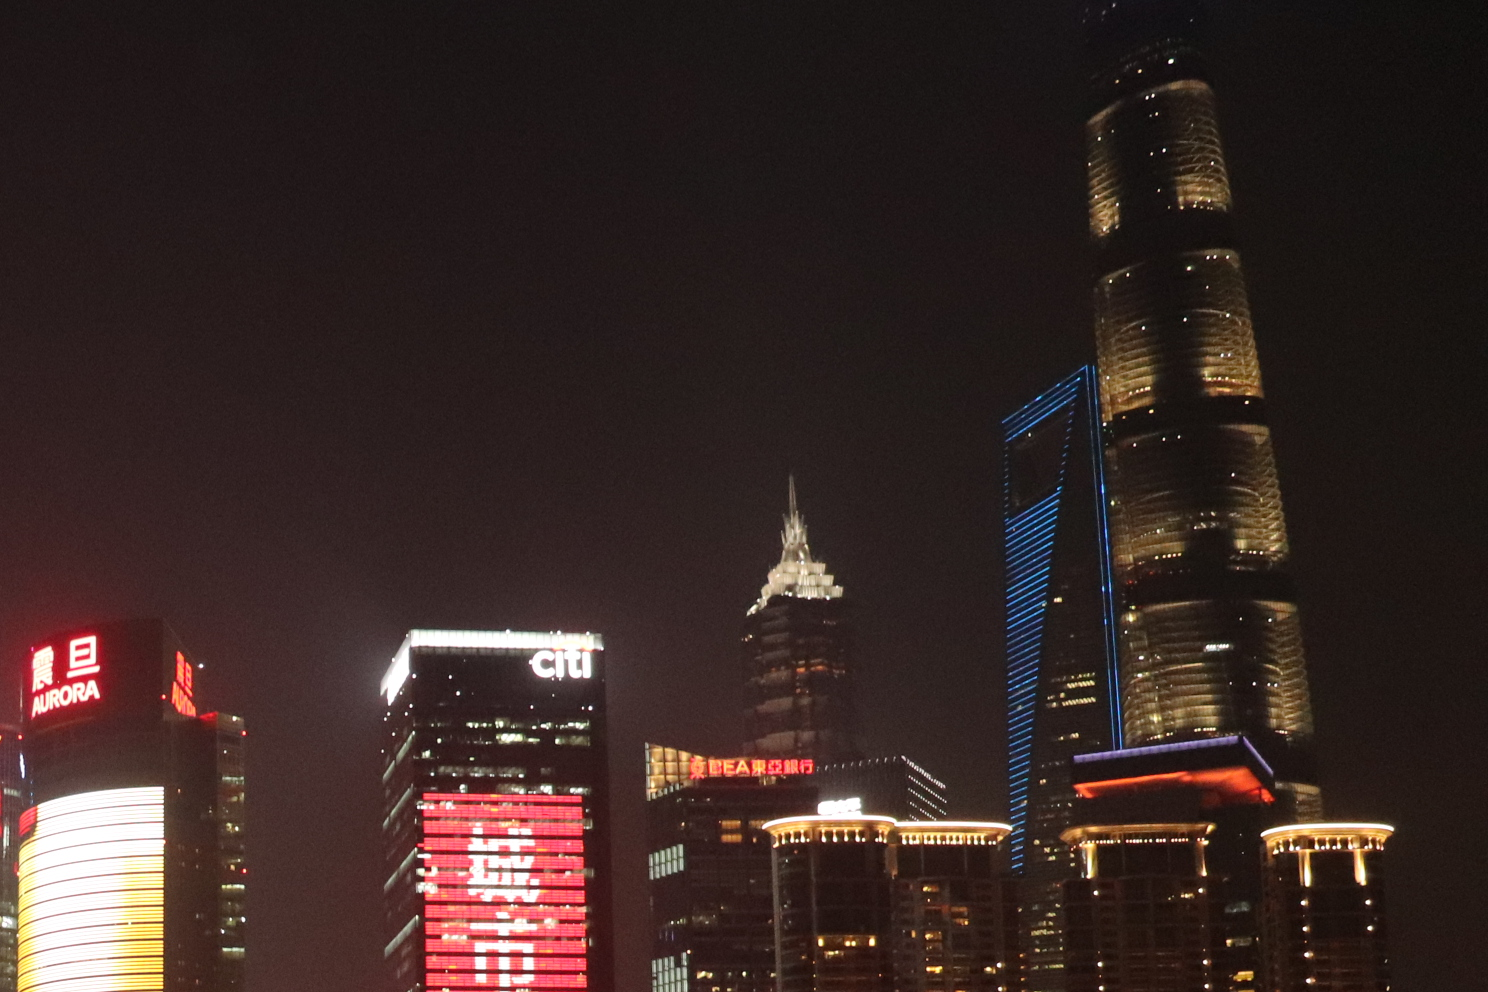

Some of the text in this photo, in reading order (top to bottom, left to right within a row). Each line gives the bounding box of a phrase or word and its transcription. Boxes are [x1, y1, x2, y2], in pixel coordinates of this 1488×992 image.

[32, 635, 100, 693] 震旦
[532, 648, 592, 679] citi
[31, 680, 100, 719] AURORA
[708, 758, 815, 775] BEA 東亞銀行
